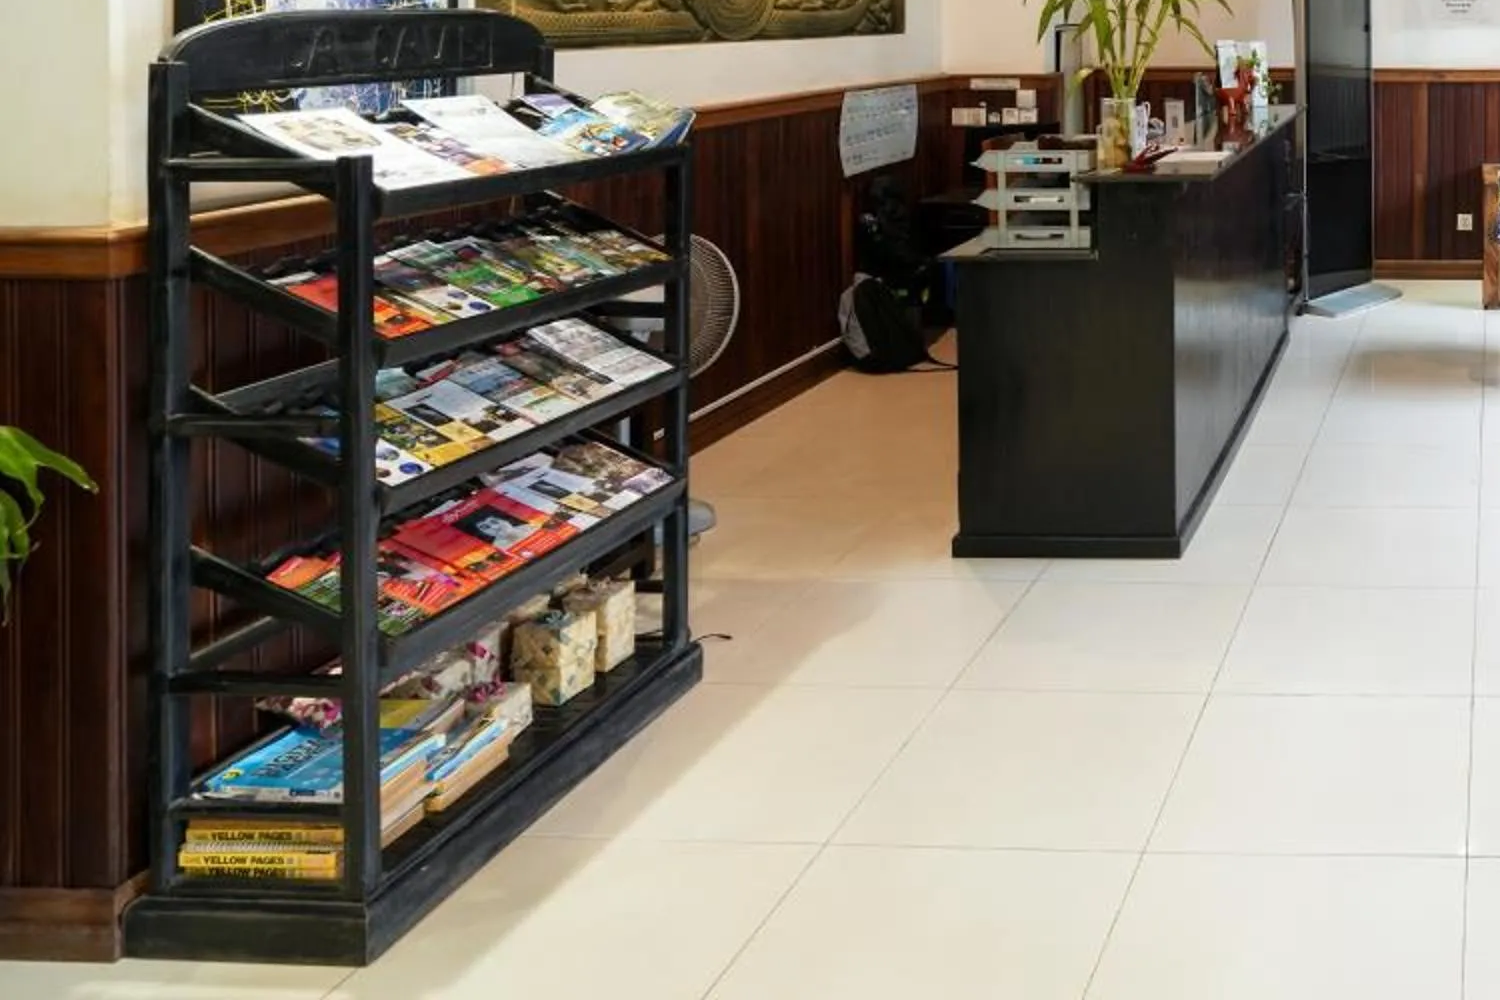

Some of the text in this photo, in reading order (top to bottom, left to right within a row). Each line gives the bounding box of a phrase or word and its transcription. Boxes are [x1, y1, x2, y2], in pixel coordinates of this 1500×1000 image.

[211, 831, 255, 841] YELLOW
[258, 831, 292, 841] PAGES
[203, 855, 248, 865] YELLOW
[250, 855, 285, 865] PAGES
